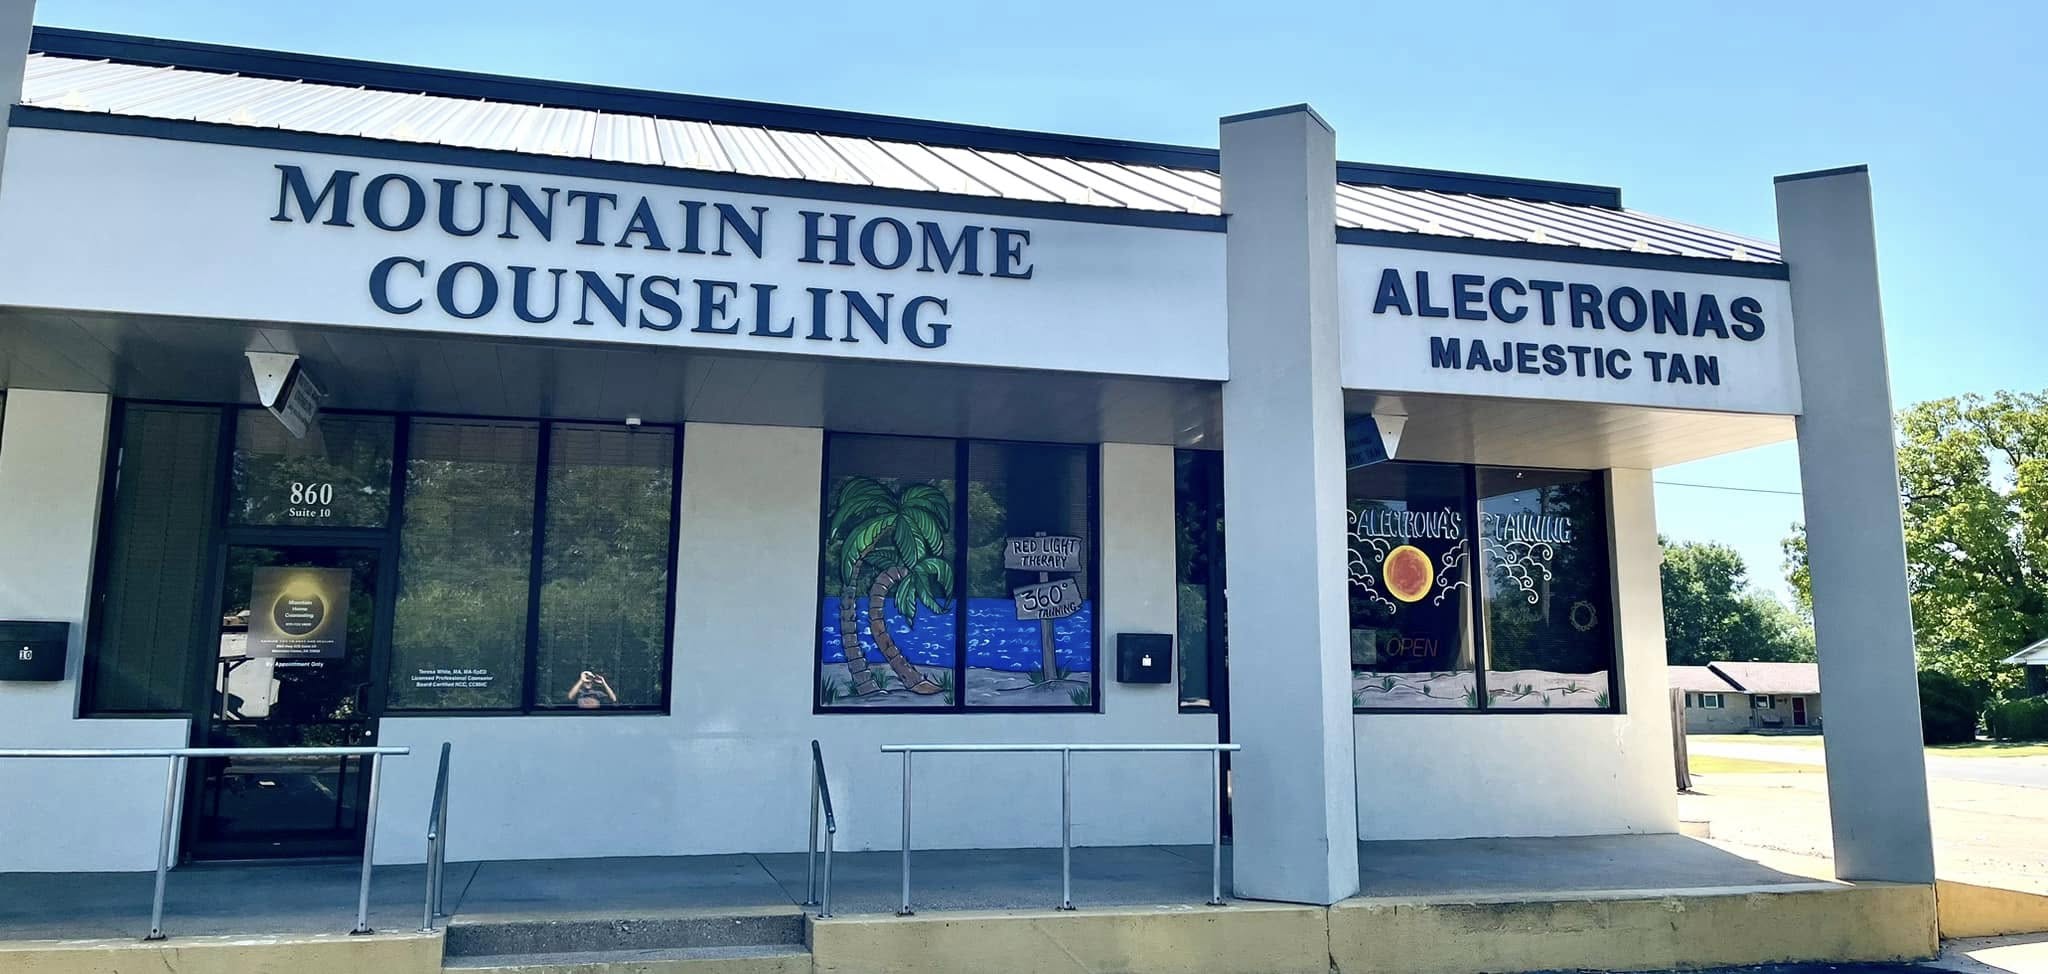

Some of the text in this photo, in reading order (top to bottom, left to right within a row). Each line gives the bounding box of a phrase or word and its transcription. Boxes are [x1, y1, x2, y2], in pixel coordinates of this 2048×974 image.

[269, 164, 1034, 280] MOUNTAIN HOME
[368, 255, 952, 349] COUNSELING
[1372, 268, 1767, 342] ALECTRONAS
[1430, 336, 1721, 386] MAJESTIC TAN
[290, 482, 333, 505] 860
[289, 507, 331, 518] Suite 10
[1494, 512, 1572, 544] TANNING
[1012, 537, 1075, 556] RED LIGHT
[1021, 554, 1067, 570] THERAPY
[1038, 601, 1077, 619] TANNING
[19, 650, 33, 661] 10
[1386, 637, 1439, 657] OPEN
